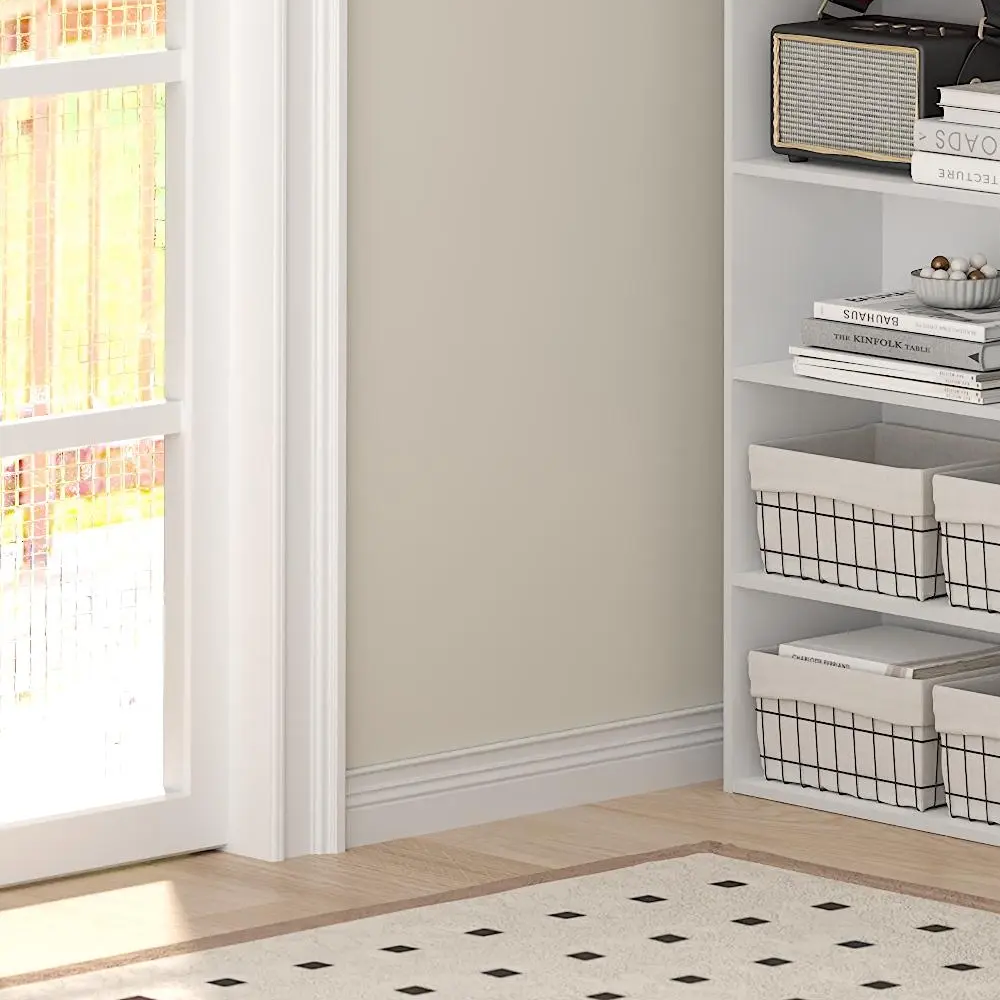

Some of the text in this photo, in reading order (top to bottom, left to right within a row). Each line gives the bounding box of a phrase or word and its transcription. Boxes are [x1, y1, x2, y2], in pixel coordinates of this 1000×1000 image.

[843, 309, 899, 327] BAUHAUS
[833, 333, 930, 353] THE KINFOLK TABLE
